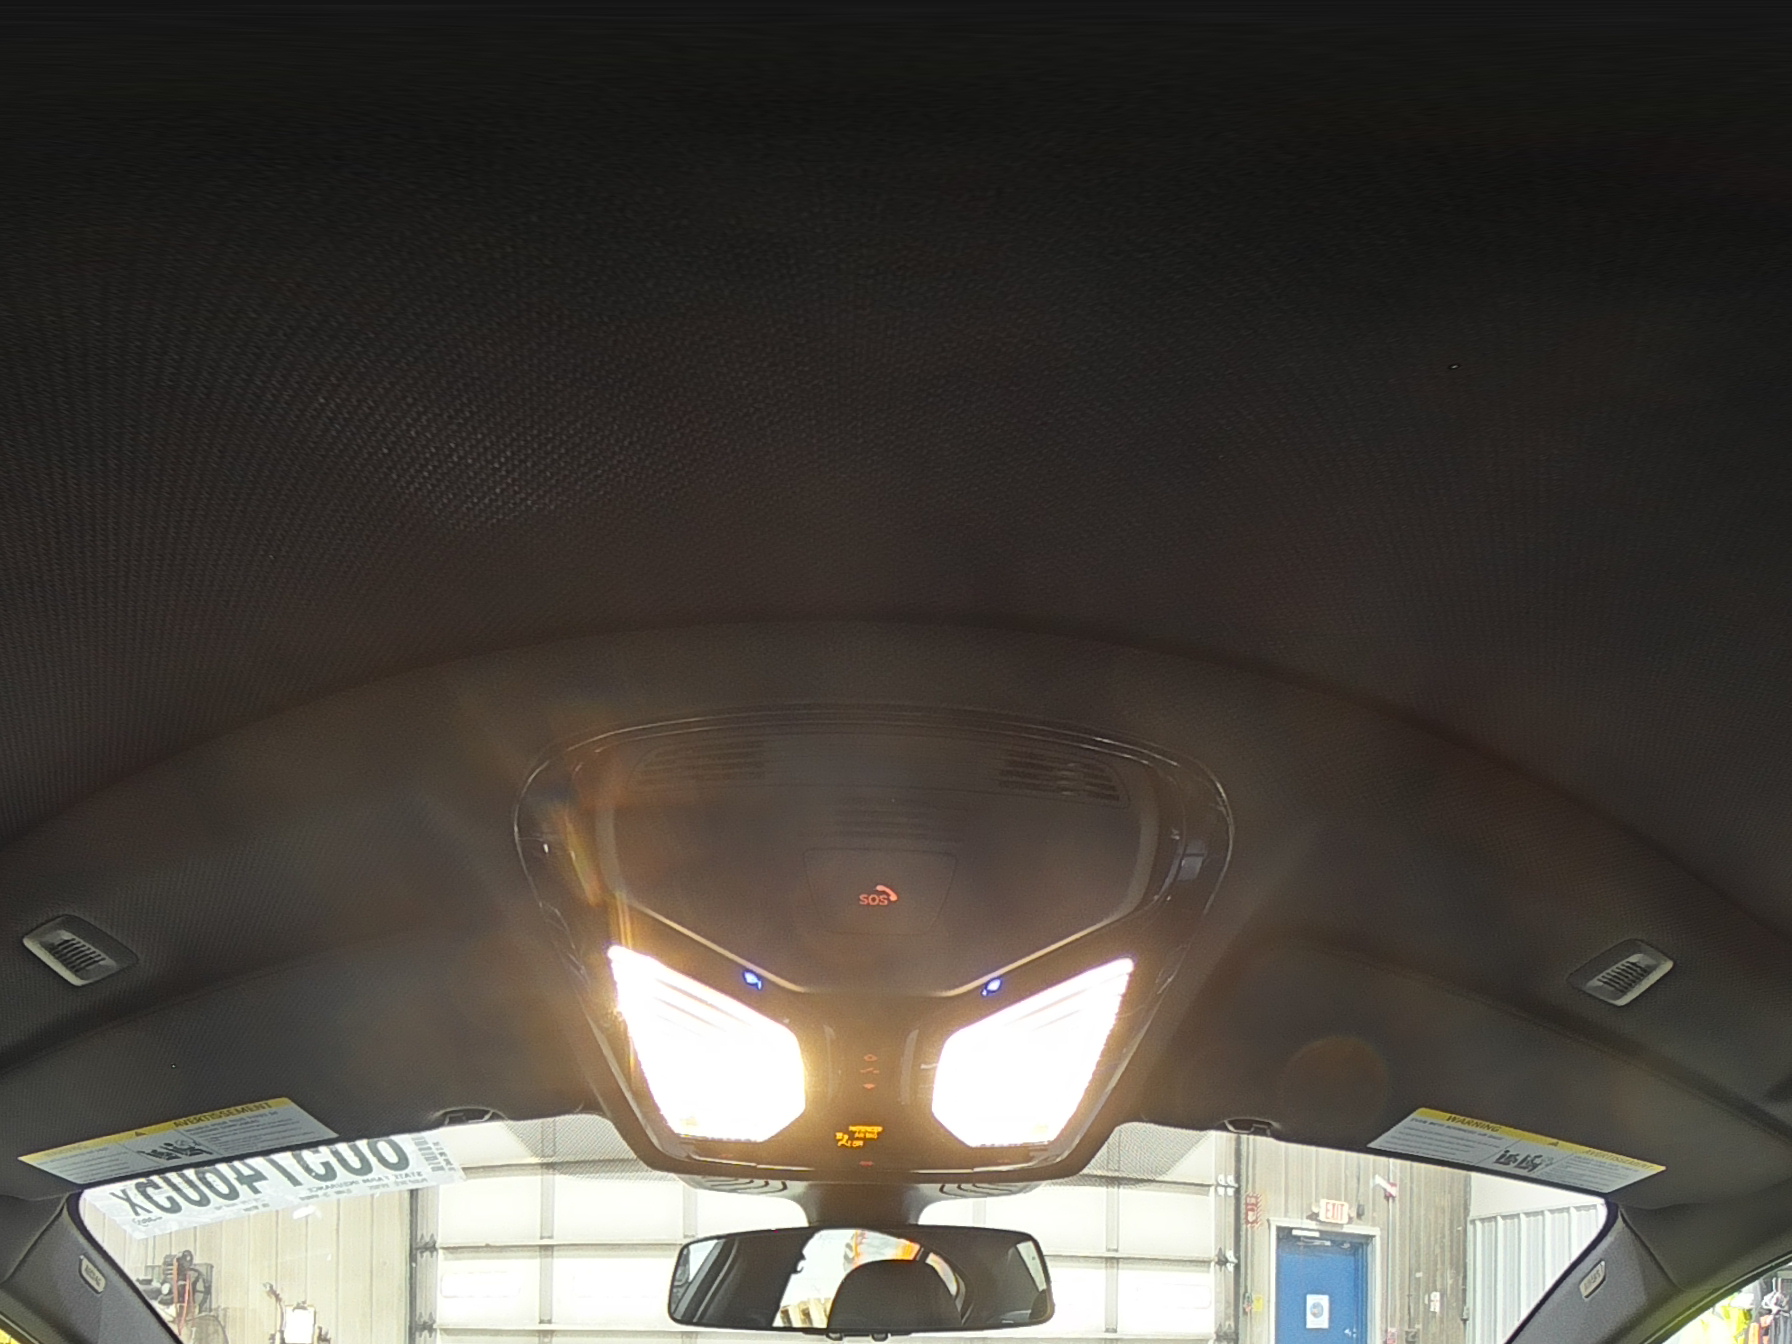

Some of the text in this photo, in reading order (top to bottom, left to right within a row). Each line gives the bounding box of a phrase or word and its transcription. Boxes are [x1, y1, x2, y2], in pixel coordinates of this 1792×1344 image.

[859, 894, 888, 906] SOS
[173, 1101, 274, 1129] AVERTISSEMENT
[1446, 1115, 1502, 1133] WARNING
[1324, 1201, 1345, 1221] EXIT
